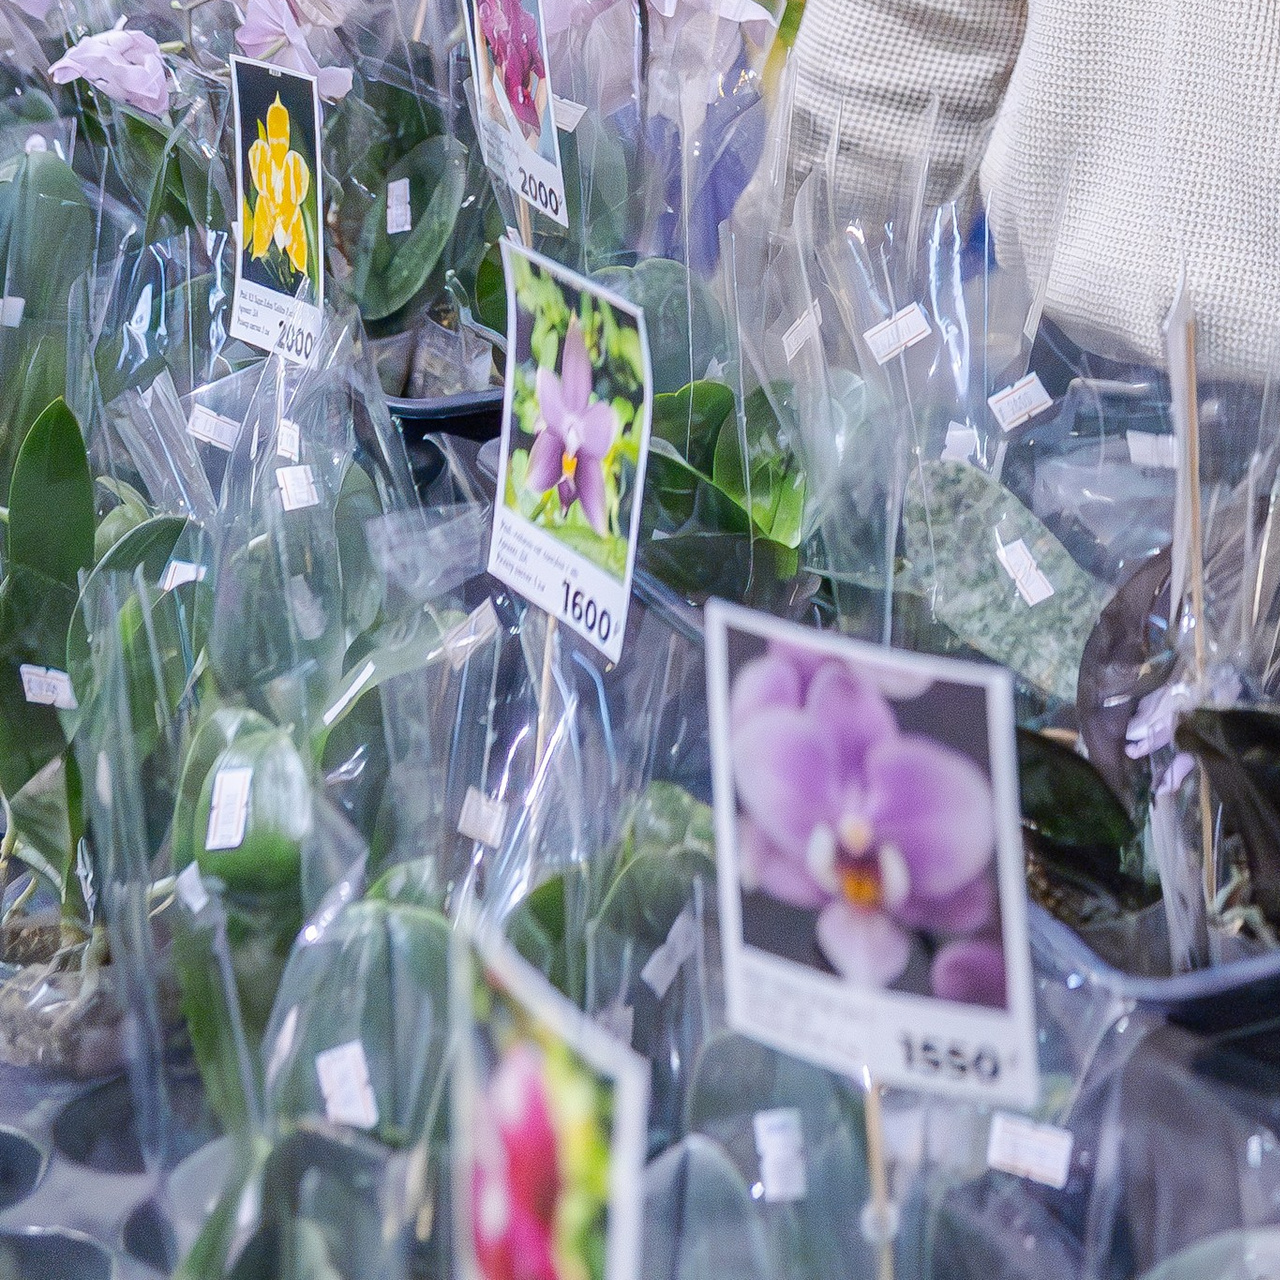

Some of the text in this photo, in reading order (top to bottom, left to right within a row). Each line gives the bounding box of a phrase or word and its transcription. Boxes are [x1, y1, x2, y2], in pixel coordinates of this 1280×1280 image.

[519, 166, 559, 216] 2000
[562, 579, 611, 642] 1600
[902, 1031, 999, 1082] 1550
